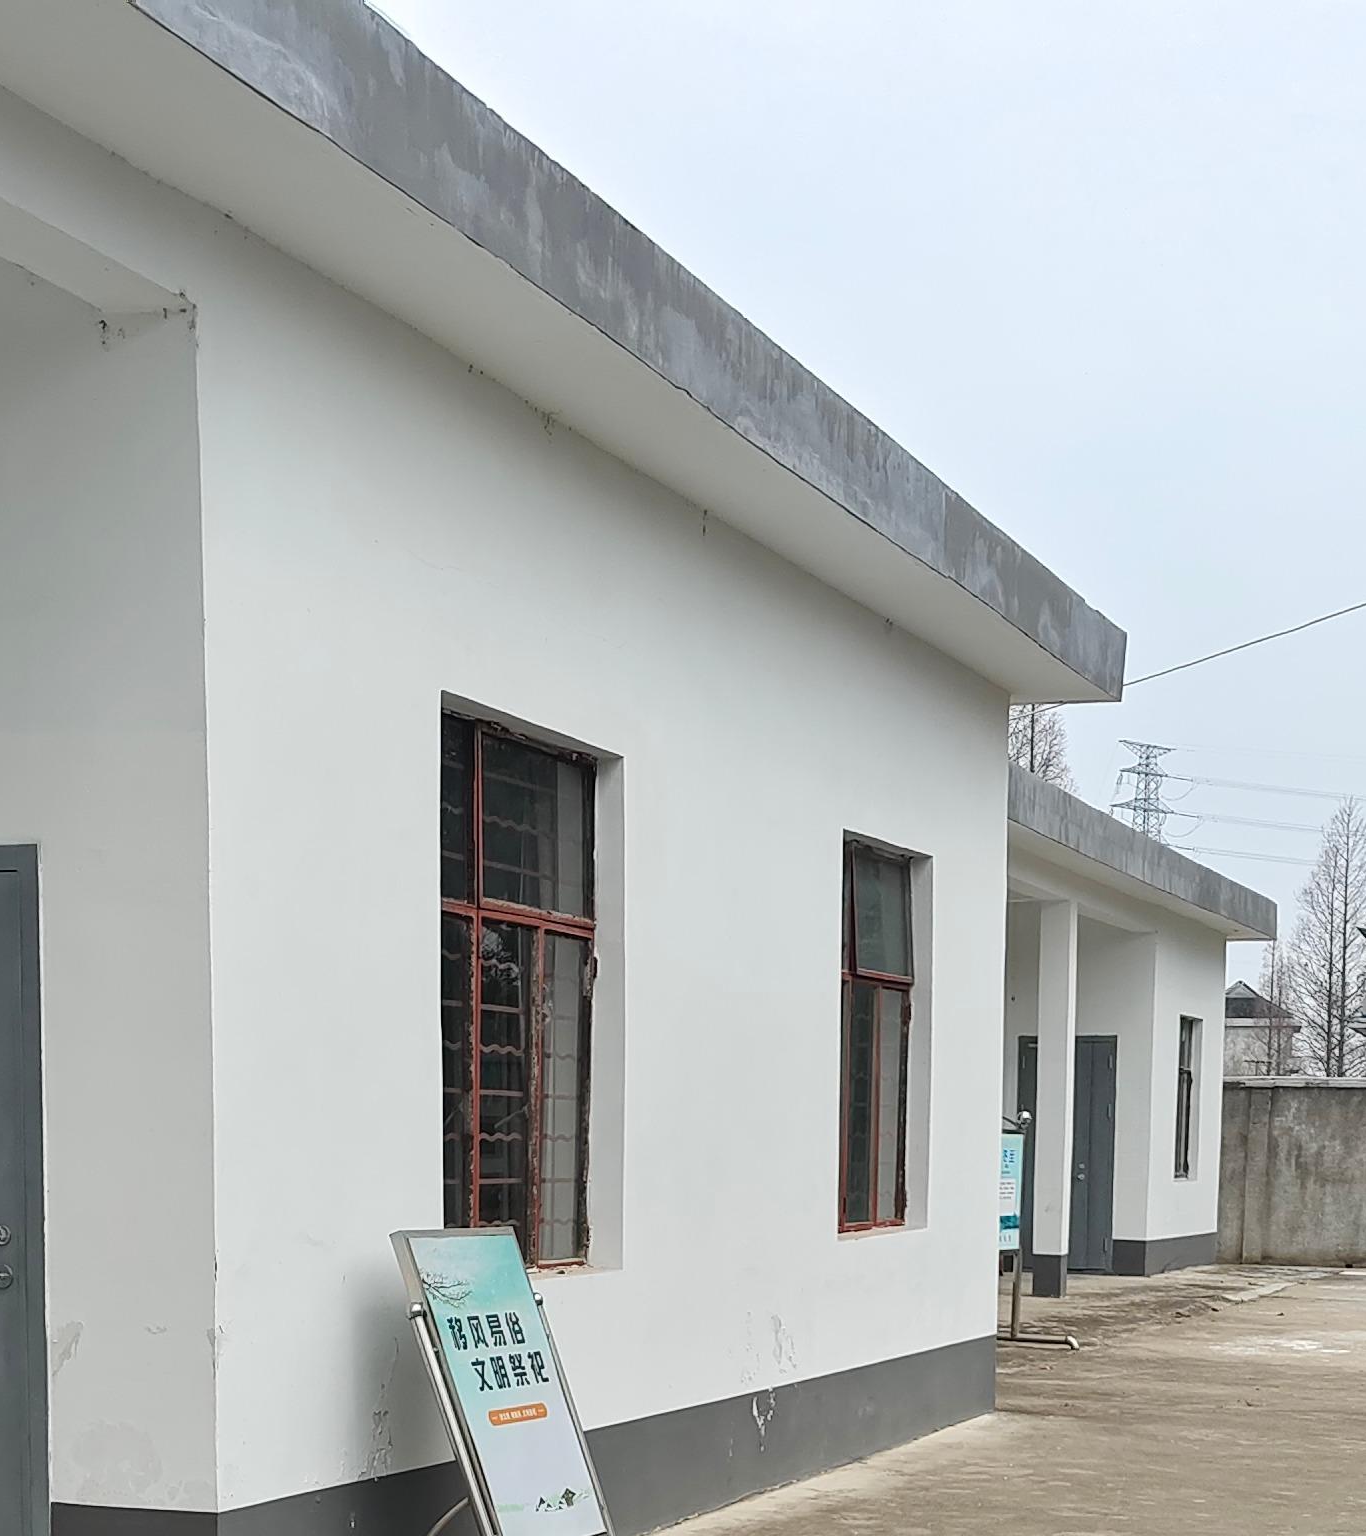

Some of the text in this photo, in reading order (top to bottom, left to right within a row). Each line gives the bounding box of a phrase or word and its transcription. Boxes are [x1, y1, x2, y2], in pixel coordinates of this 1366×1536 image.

[446, 1312, 526, 1350] 移风易俗
[471, 1350, 550, 1391] 文明祭祀
